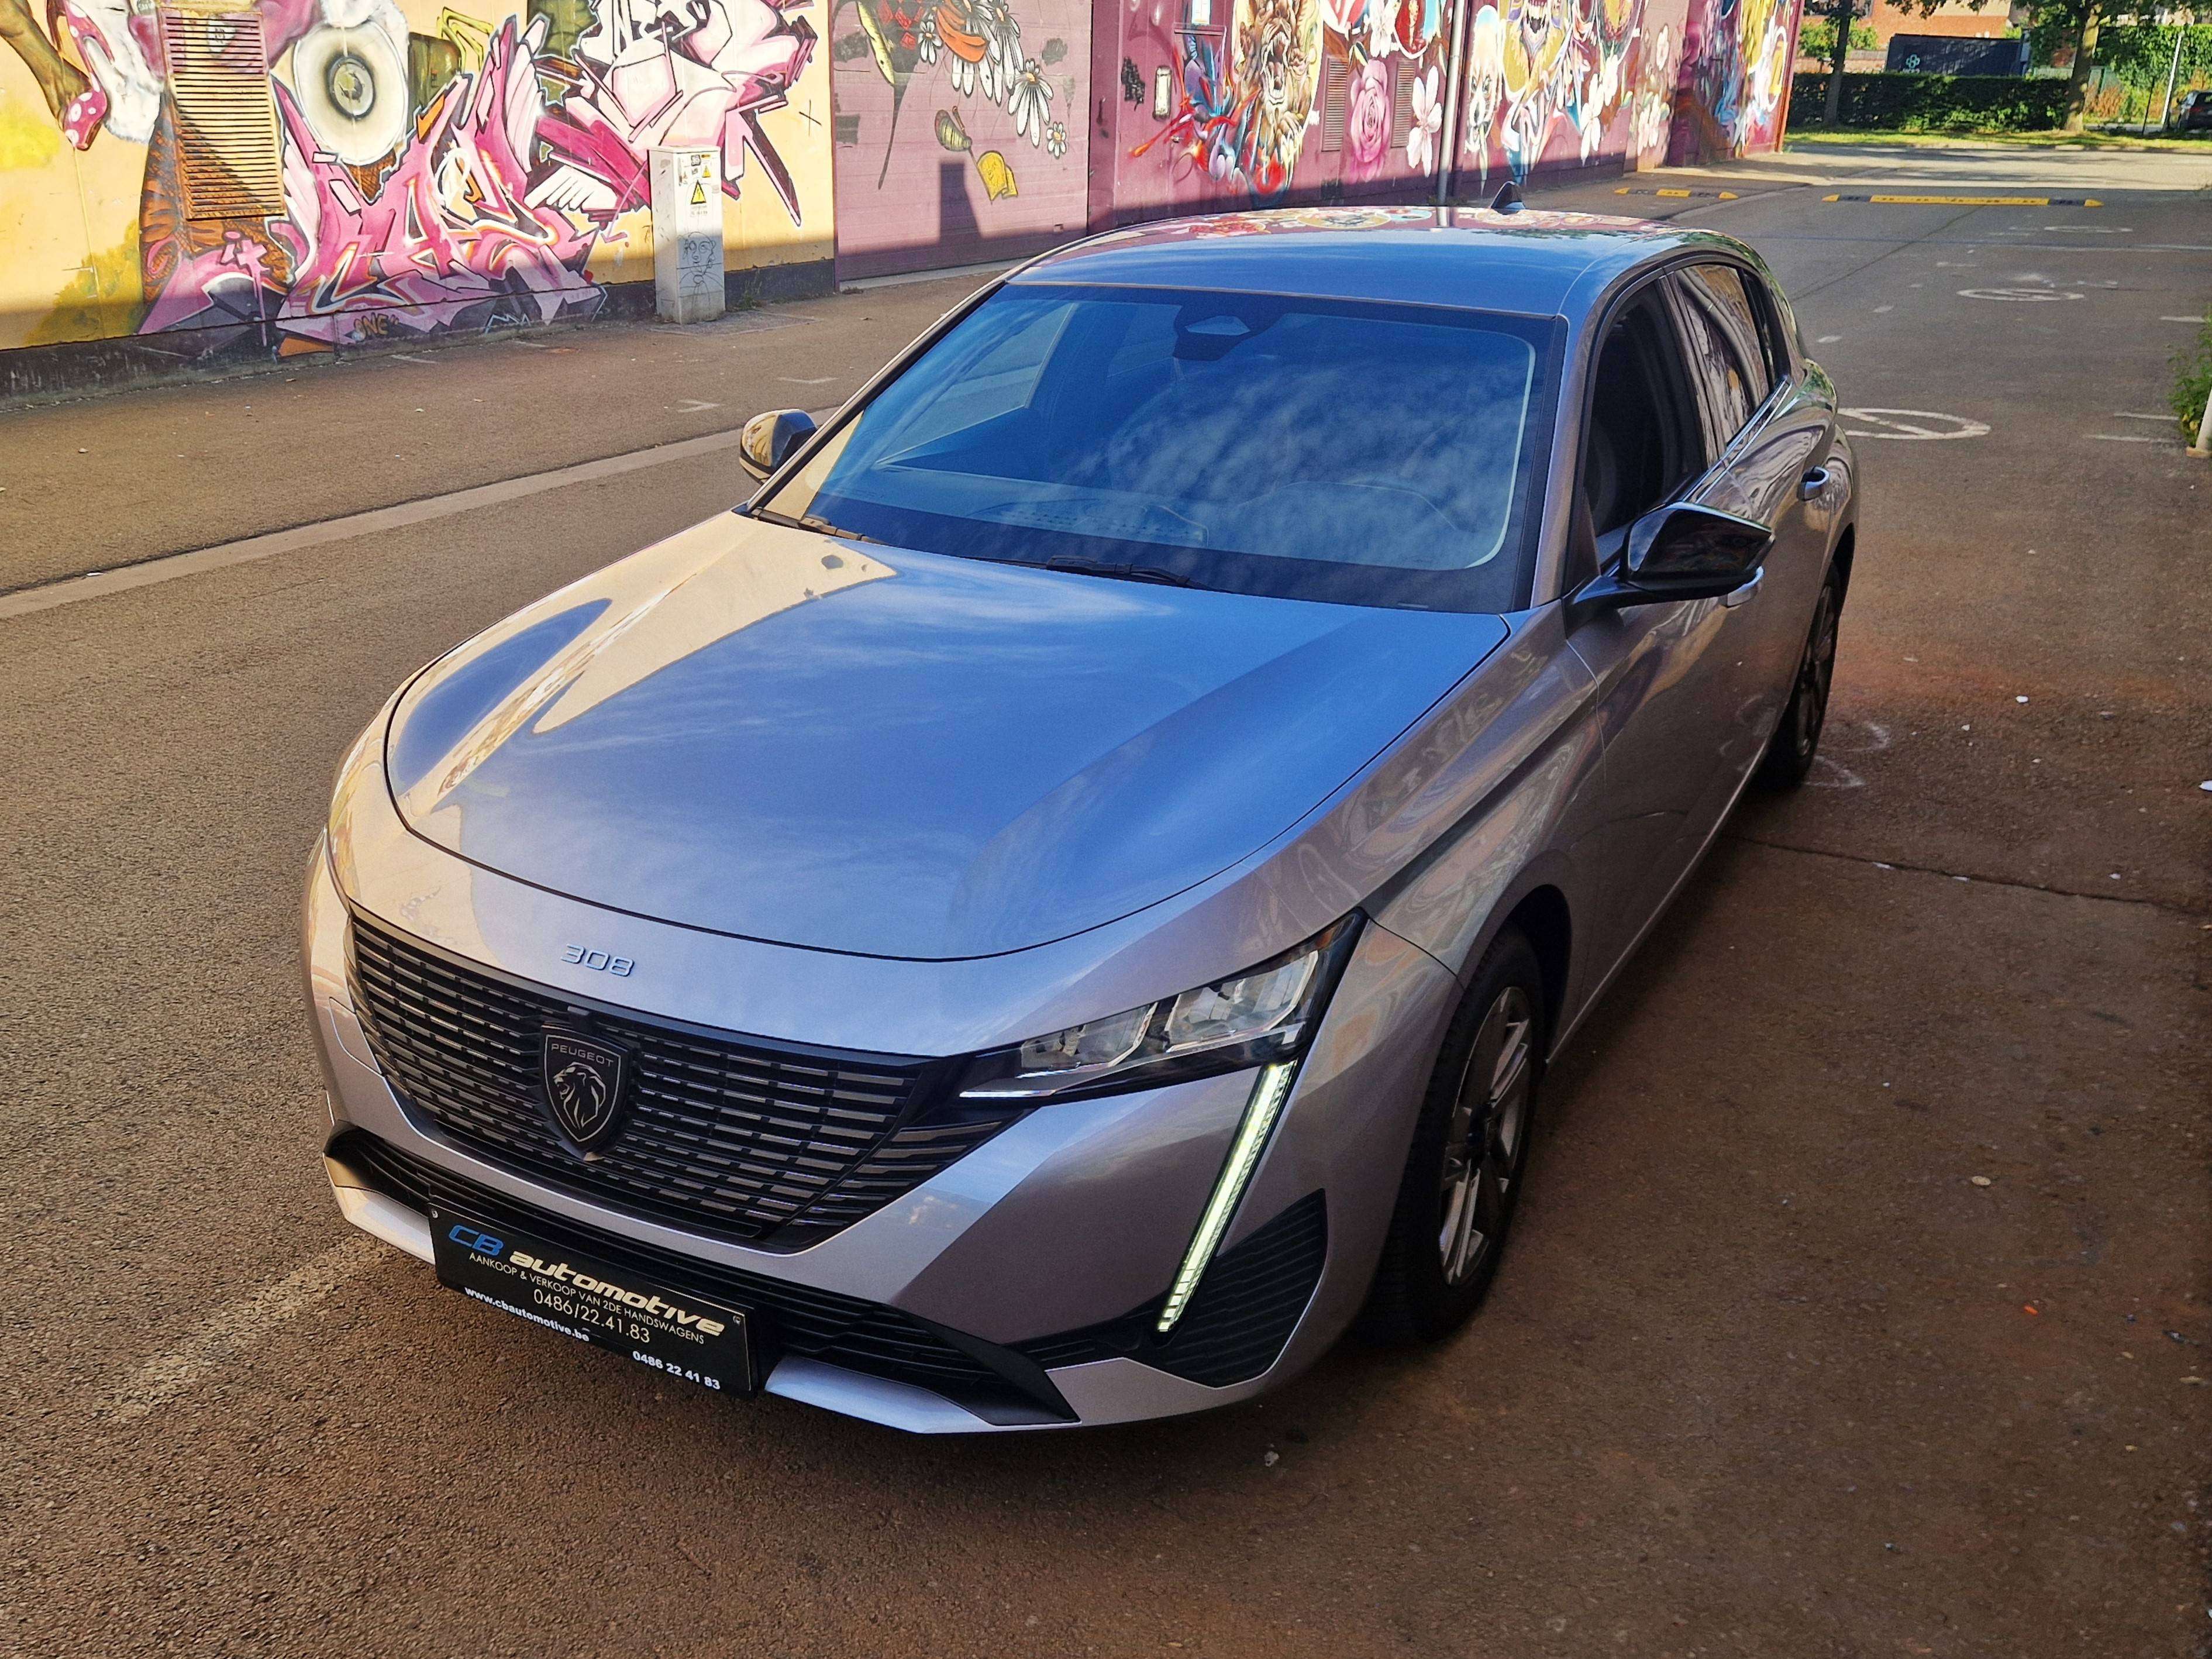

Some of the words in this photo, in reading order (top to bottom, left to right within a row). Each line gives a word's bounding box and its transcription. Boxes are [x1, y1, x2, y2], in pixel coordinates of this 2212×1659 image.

[561, 944, 634, 976] 308
[551, 1044, 614, 1067] PEUGEOT
[449, 1225, 504, 1256] CB
[509, 1250, 725, 1337] automotive
[469, 1252, 517, 1276] AANKOOP
[520, 1271, 527, 1281] &
[530, 1274, 577, 1297] VERKOOP
[580, 1292, 600, 1306] VAN
[604, 1300, 622, 1314] 2DE
[625, 1309, 704, 1344] HANDSWAGENS
[464, 1288, 590, 1342] www.cbautomotive.be
[533, 1289, 650, 1344] 0486/22.41.83
[632, 1350, 663, 1369] 0486
[666, 1362, 682, 1377] 22
[685, 1370, 700, 1383] 41
[704, 1376, 721, 1390] 83
